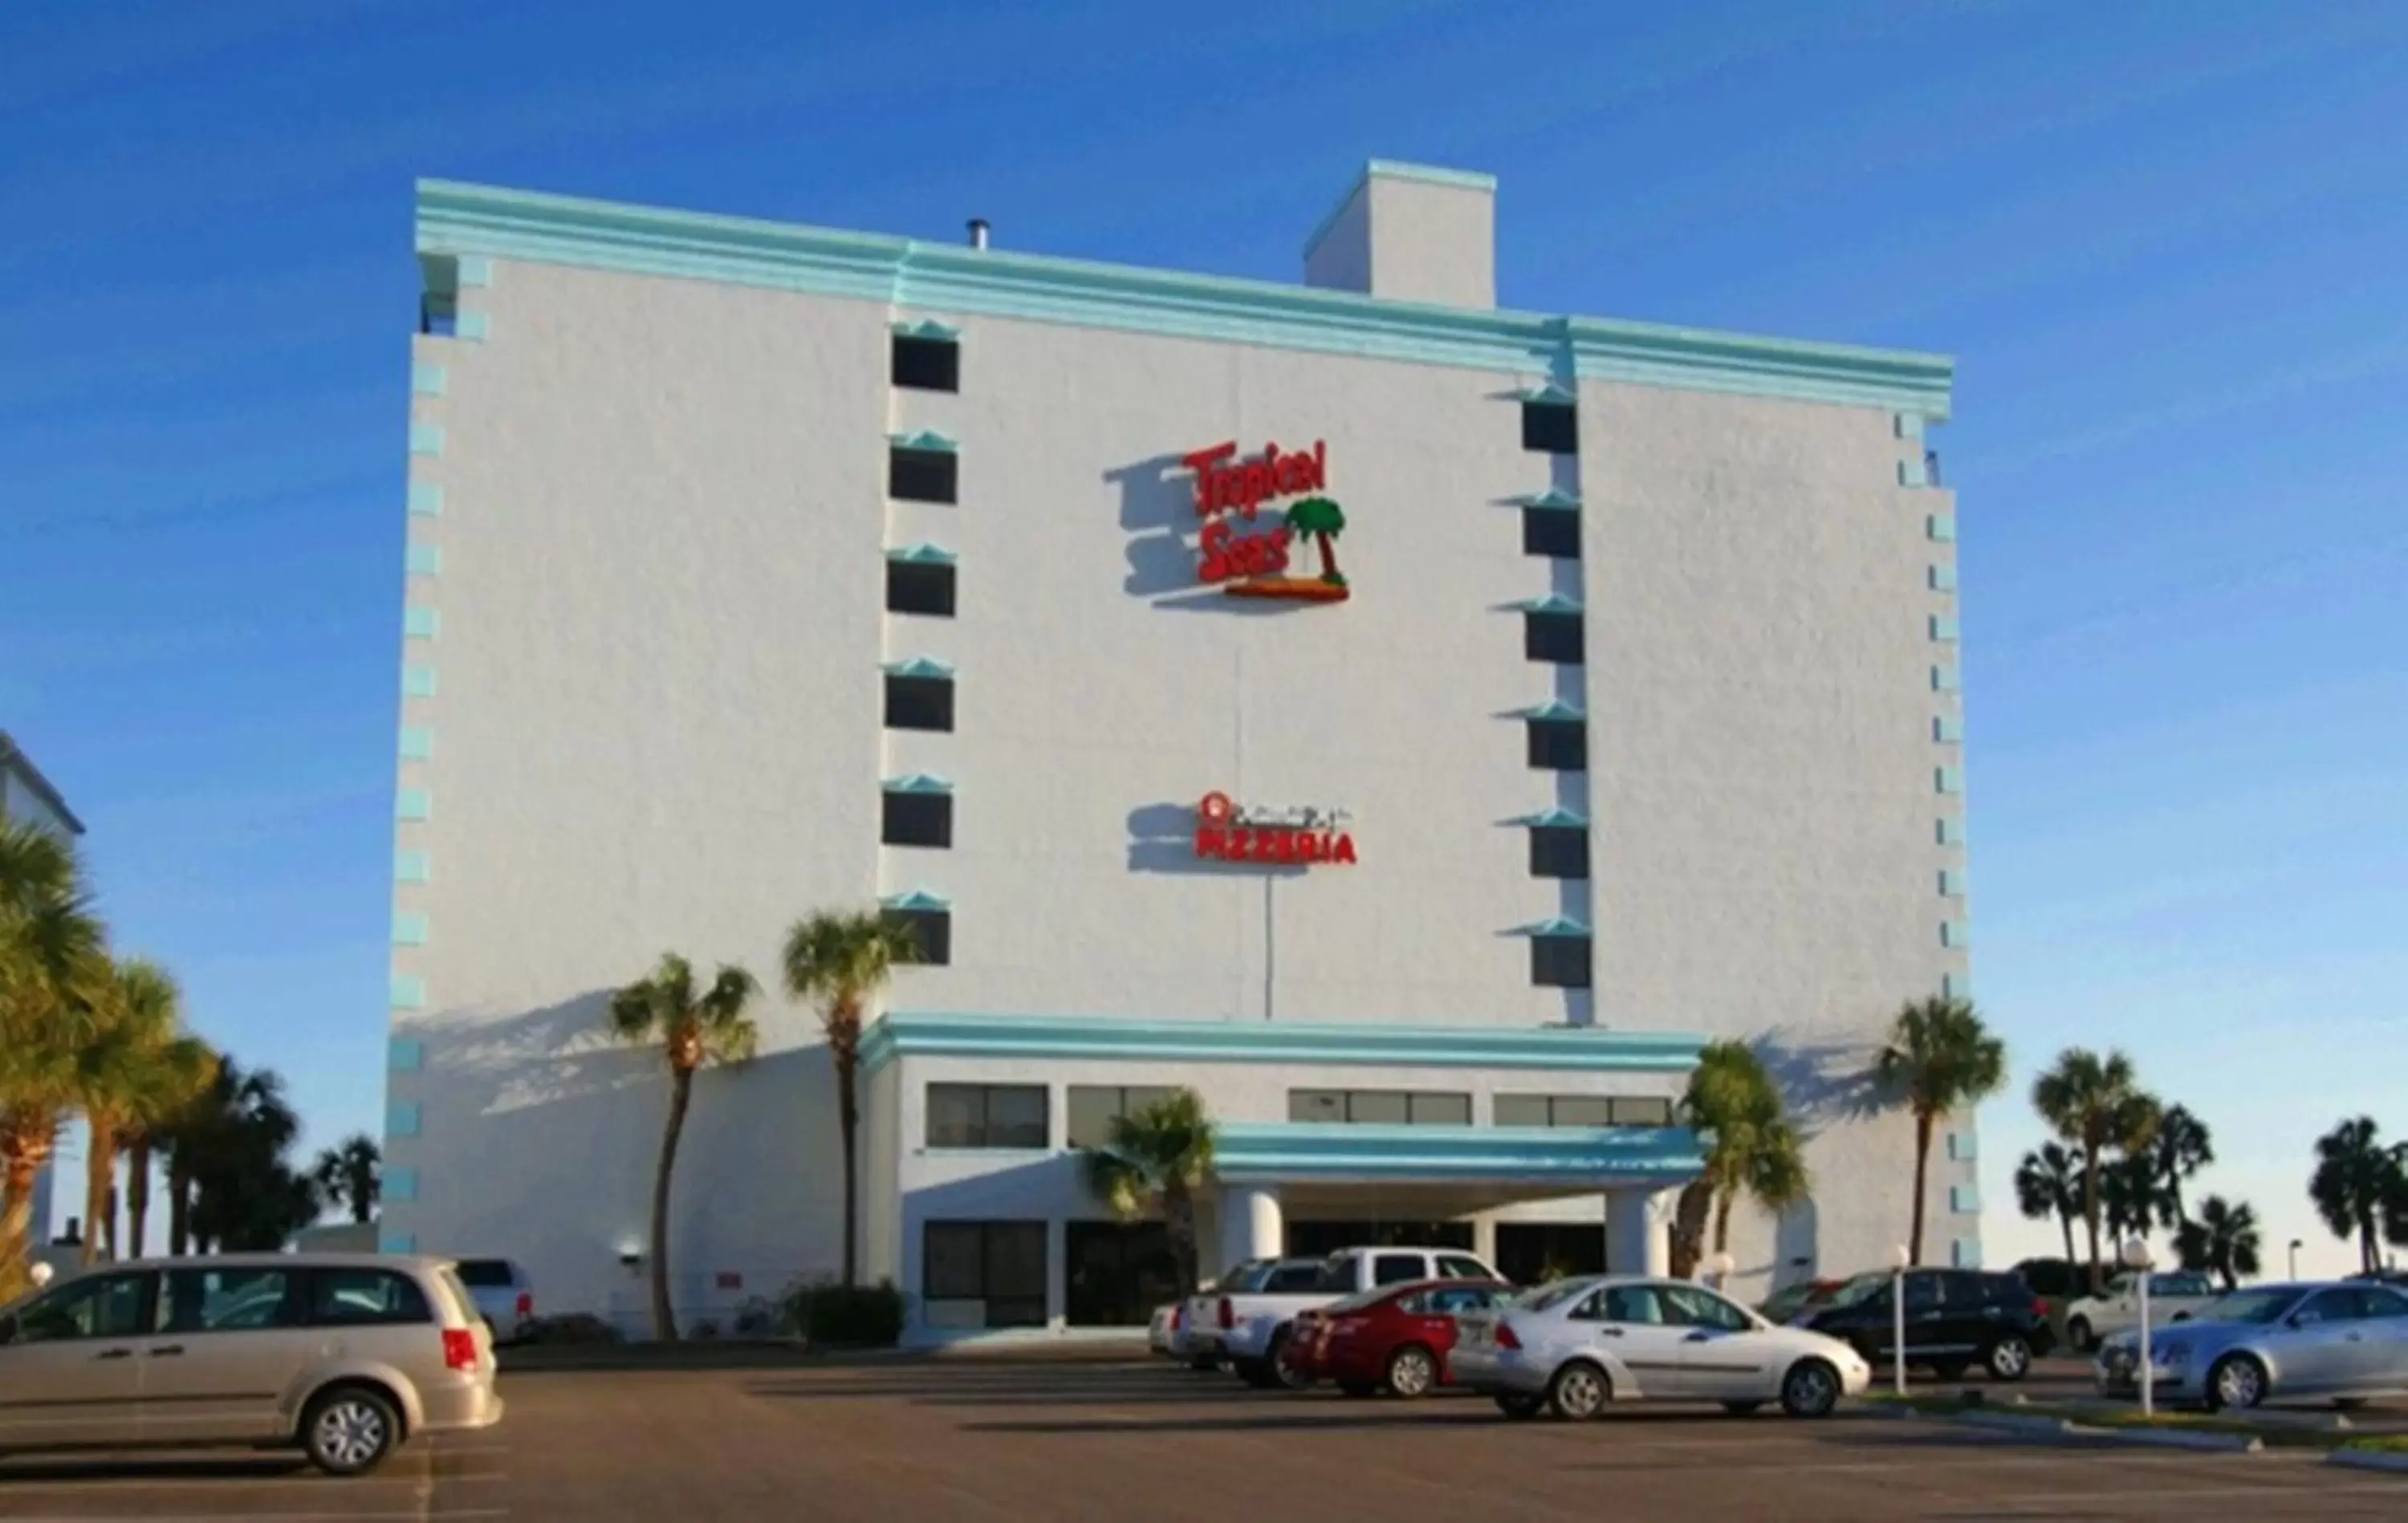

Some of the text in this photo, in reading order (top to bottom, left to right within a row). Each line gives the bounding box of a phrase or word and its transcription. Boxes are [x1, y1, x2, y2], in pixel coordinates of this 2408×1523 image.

[1182, 440, 1324, 521] Tropical
[1198, 522, 1291, 582] Seas
[1196, 828, 1357, 863] PIZZERIA
